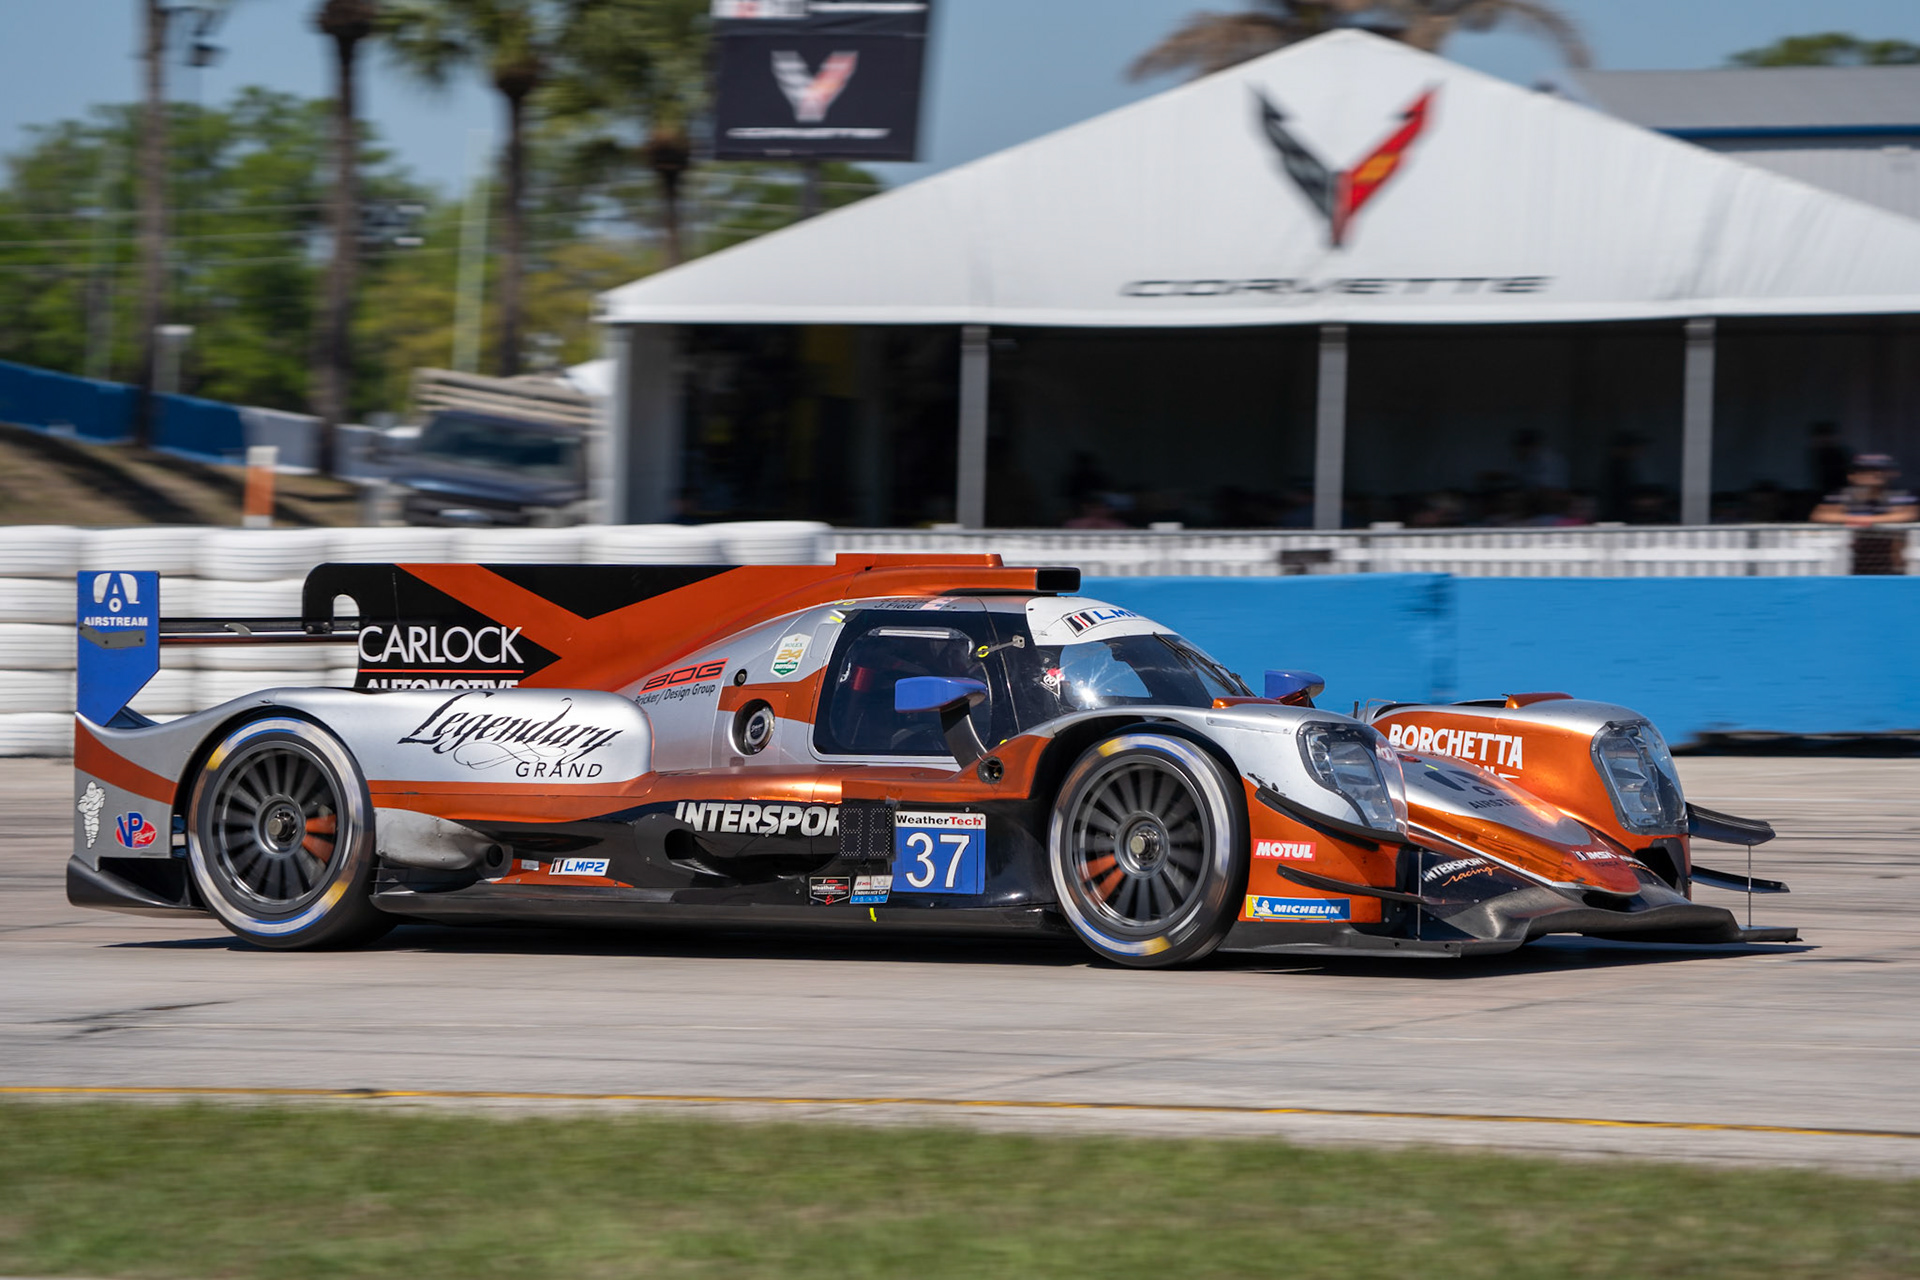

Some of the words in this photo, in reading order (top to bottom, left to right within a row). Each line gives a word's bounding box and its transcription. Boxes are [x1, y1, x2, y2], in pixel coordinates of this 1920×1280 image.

[83, 616, 149, 627] AIRSTREAM
[358, 625, 525, 664] CARLOCK
[776, 648, 804, 660] 24
[692, 683, 716, 697] Group
[397, 690, 624, 771] Legendary
[1388, 723, 1523, 770] BORCHETTA
[515, 762, 603, 778] GRAND
[896, 814, 982, 826] WeatherTech
[116, 811, 144, 848] VP
[1255, 841, 1313, 859] MOTUL
[564, 861, 606, 872] LMP2
[906, 832, 970, 888] 37
[1421, 857, 1488, 882] INTERSPORT
[1442, 866, 1500, 887] racing
[1273, 904, 1341, 914] MICHELIN
